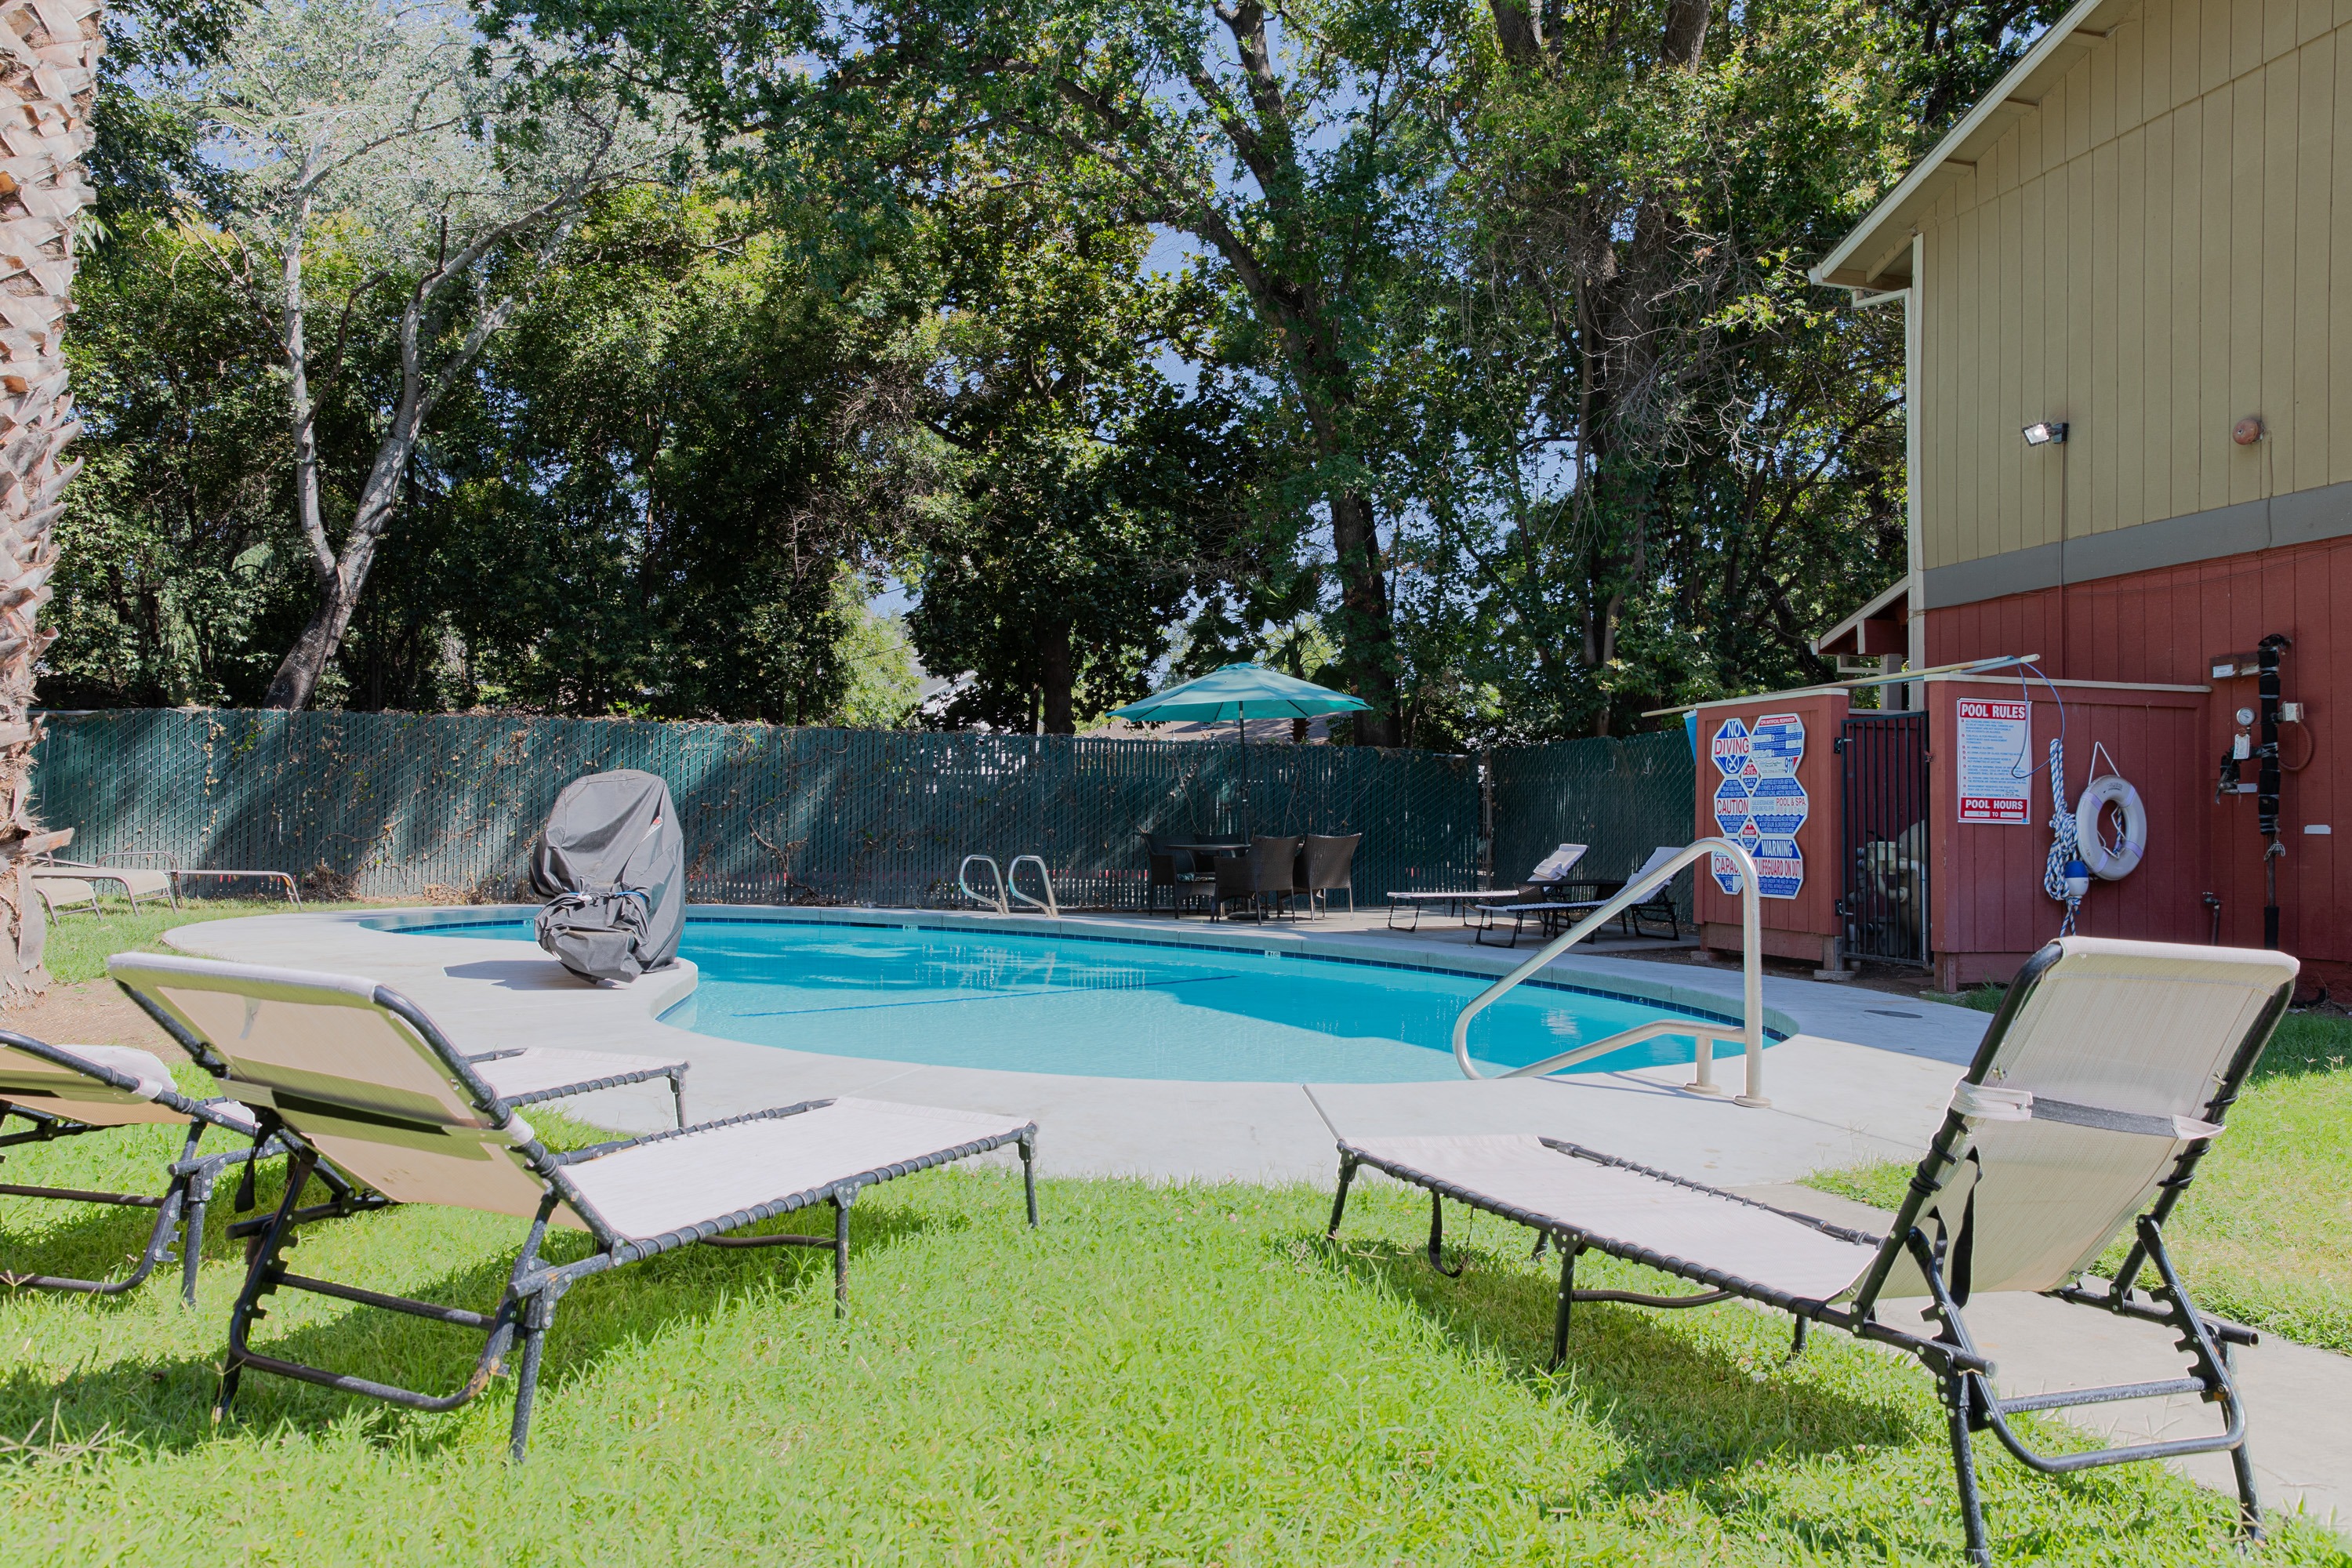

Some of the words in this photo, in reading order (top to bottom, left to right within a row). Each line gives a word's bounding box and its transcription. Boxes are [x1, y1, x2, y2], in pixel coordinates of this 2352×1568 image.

[1962, 704, 1988, 717] POOL
[1992, 705, 2025, 719] RULES
[1727, 721, 1740, 737] NO
[1715, 738, 1749, 755] DIVING
[1717, 799, 1749, 814] CAUTION
[1965, 800, 1990, 809] POOL
[1994, 800, 2023, 810] HOURS
[1761, 840, 1793, 857] WARNING
[1715, 858, 1740, 873] CAPAC
[1759, 859, 1783, 876] LIFEGUARD
[1785, 860, 1791, 876] ON
